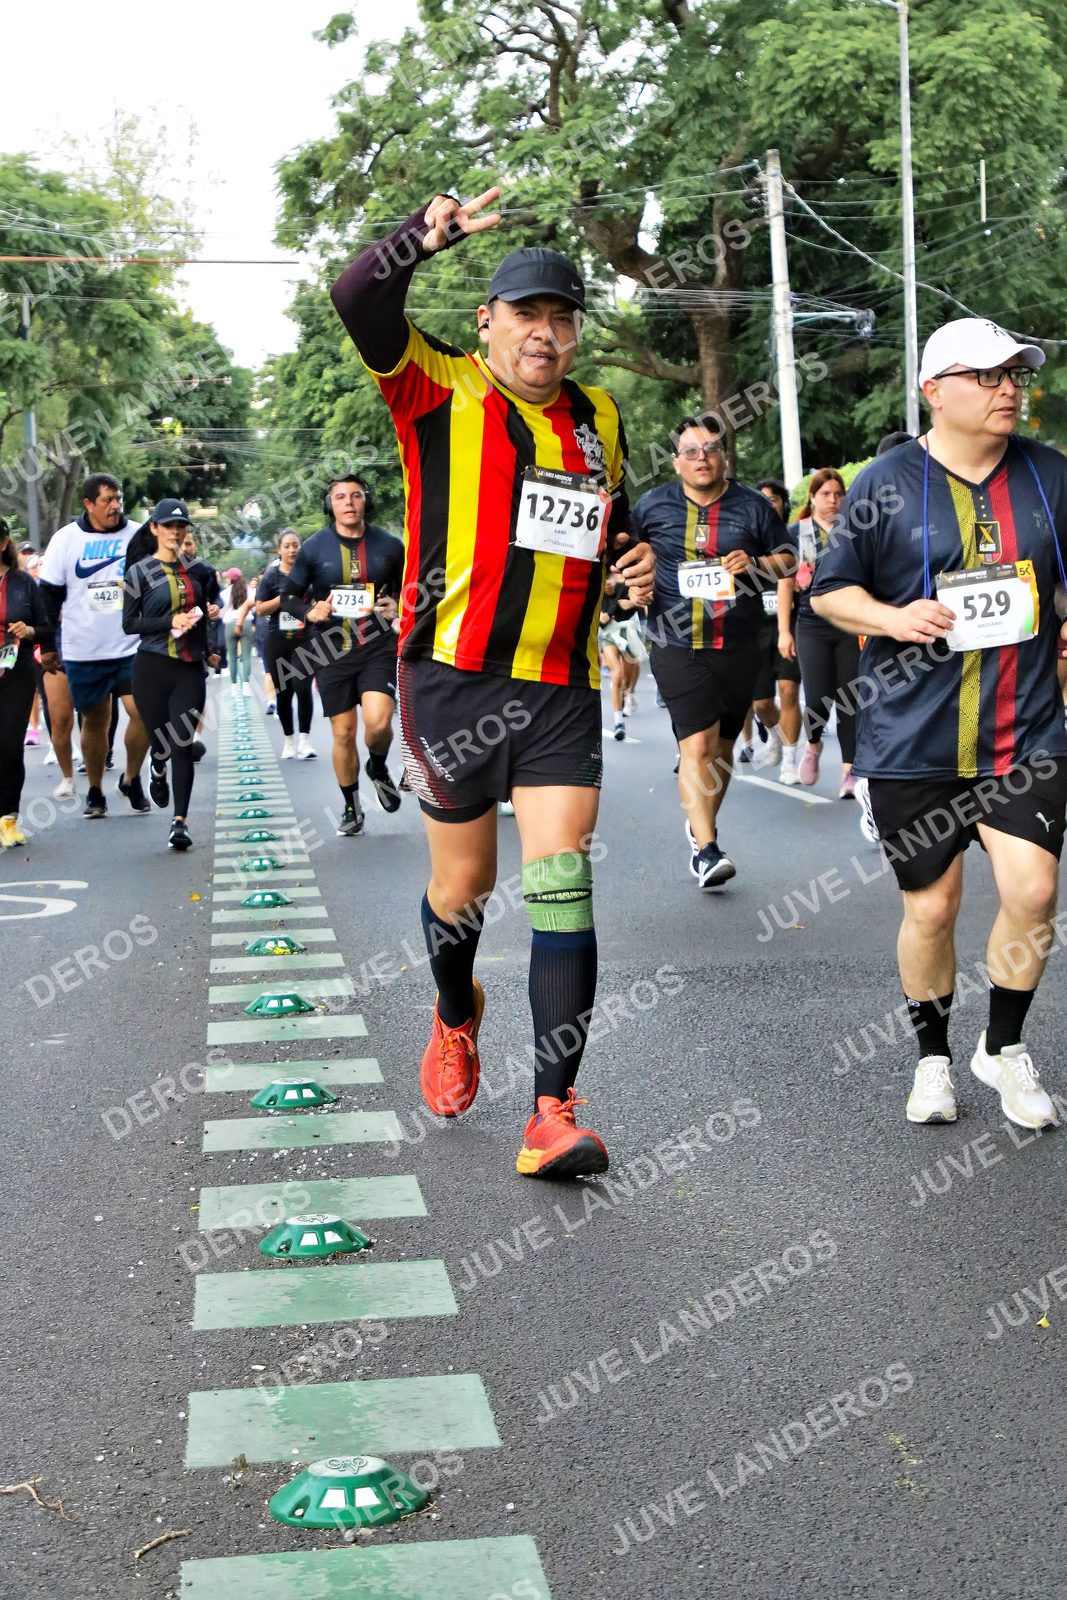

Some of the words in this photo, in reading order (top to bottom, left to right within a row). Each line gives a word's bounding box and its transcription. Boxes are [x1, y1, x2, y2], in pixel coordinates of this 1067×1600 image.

[526, 493, 600, 532] 12736
[82, 538, 123, 561] NIKE
[686, 571, 722, 588] 6715
[93, 590, 119, 601] 4428
[337, 594, 364, 606] 2734
[963, 590, 1011, 621] 529
